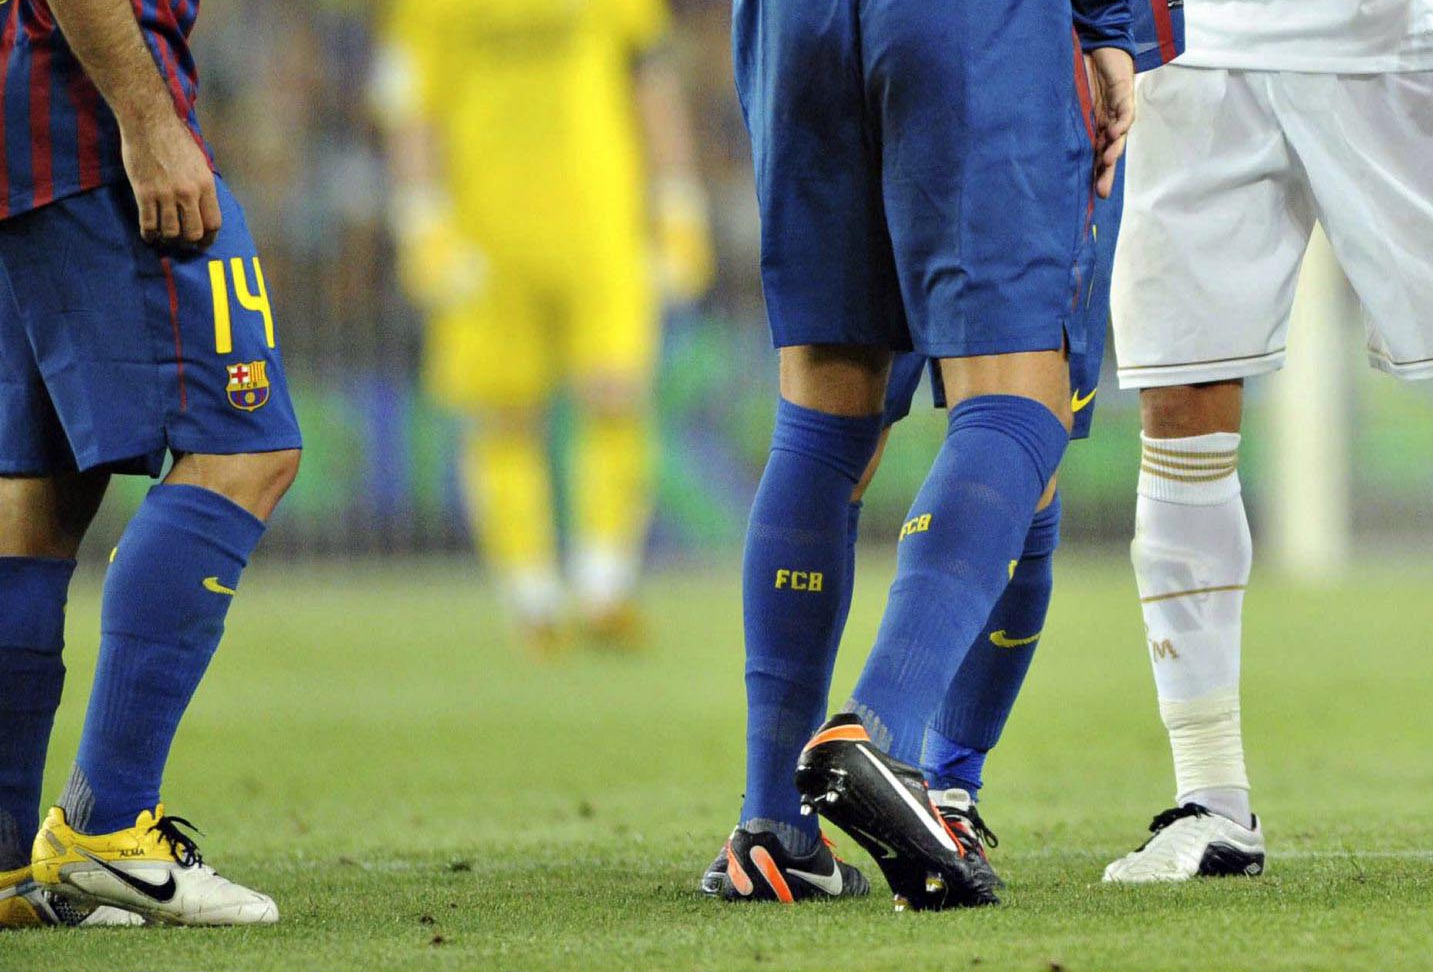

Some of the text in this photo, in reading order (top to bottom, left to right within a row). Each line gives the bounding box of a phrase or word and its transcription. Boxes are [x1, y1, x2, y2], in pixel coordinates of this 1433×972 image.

[208, 256, 275, 354] 14
[898, 513, 932, 541] FCB
[774, 569, 824, 592] FCB
